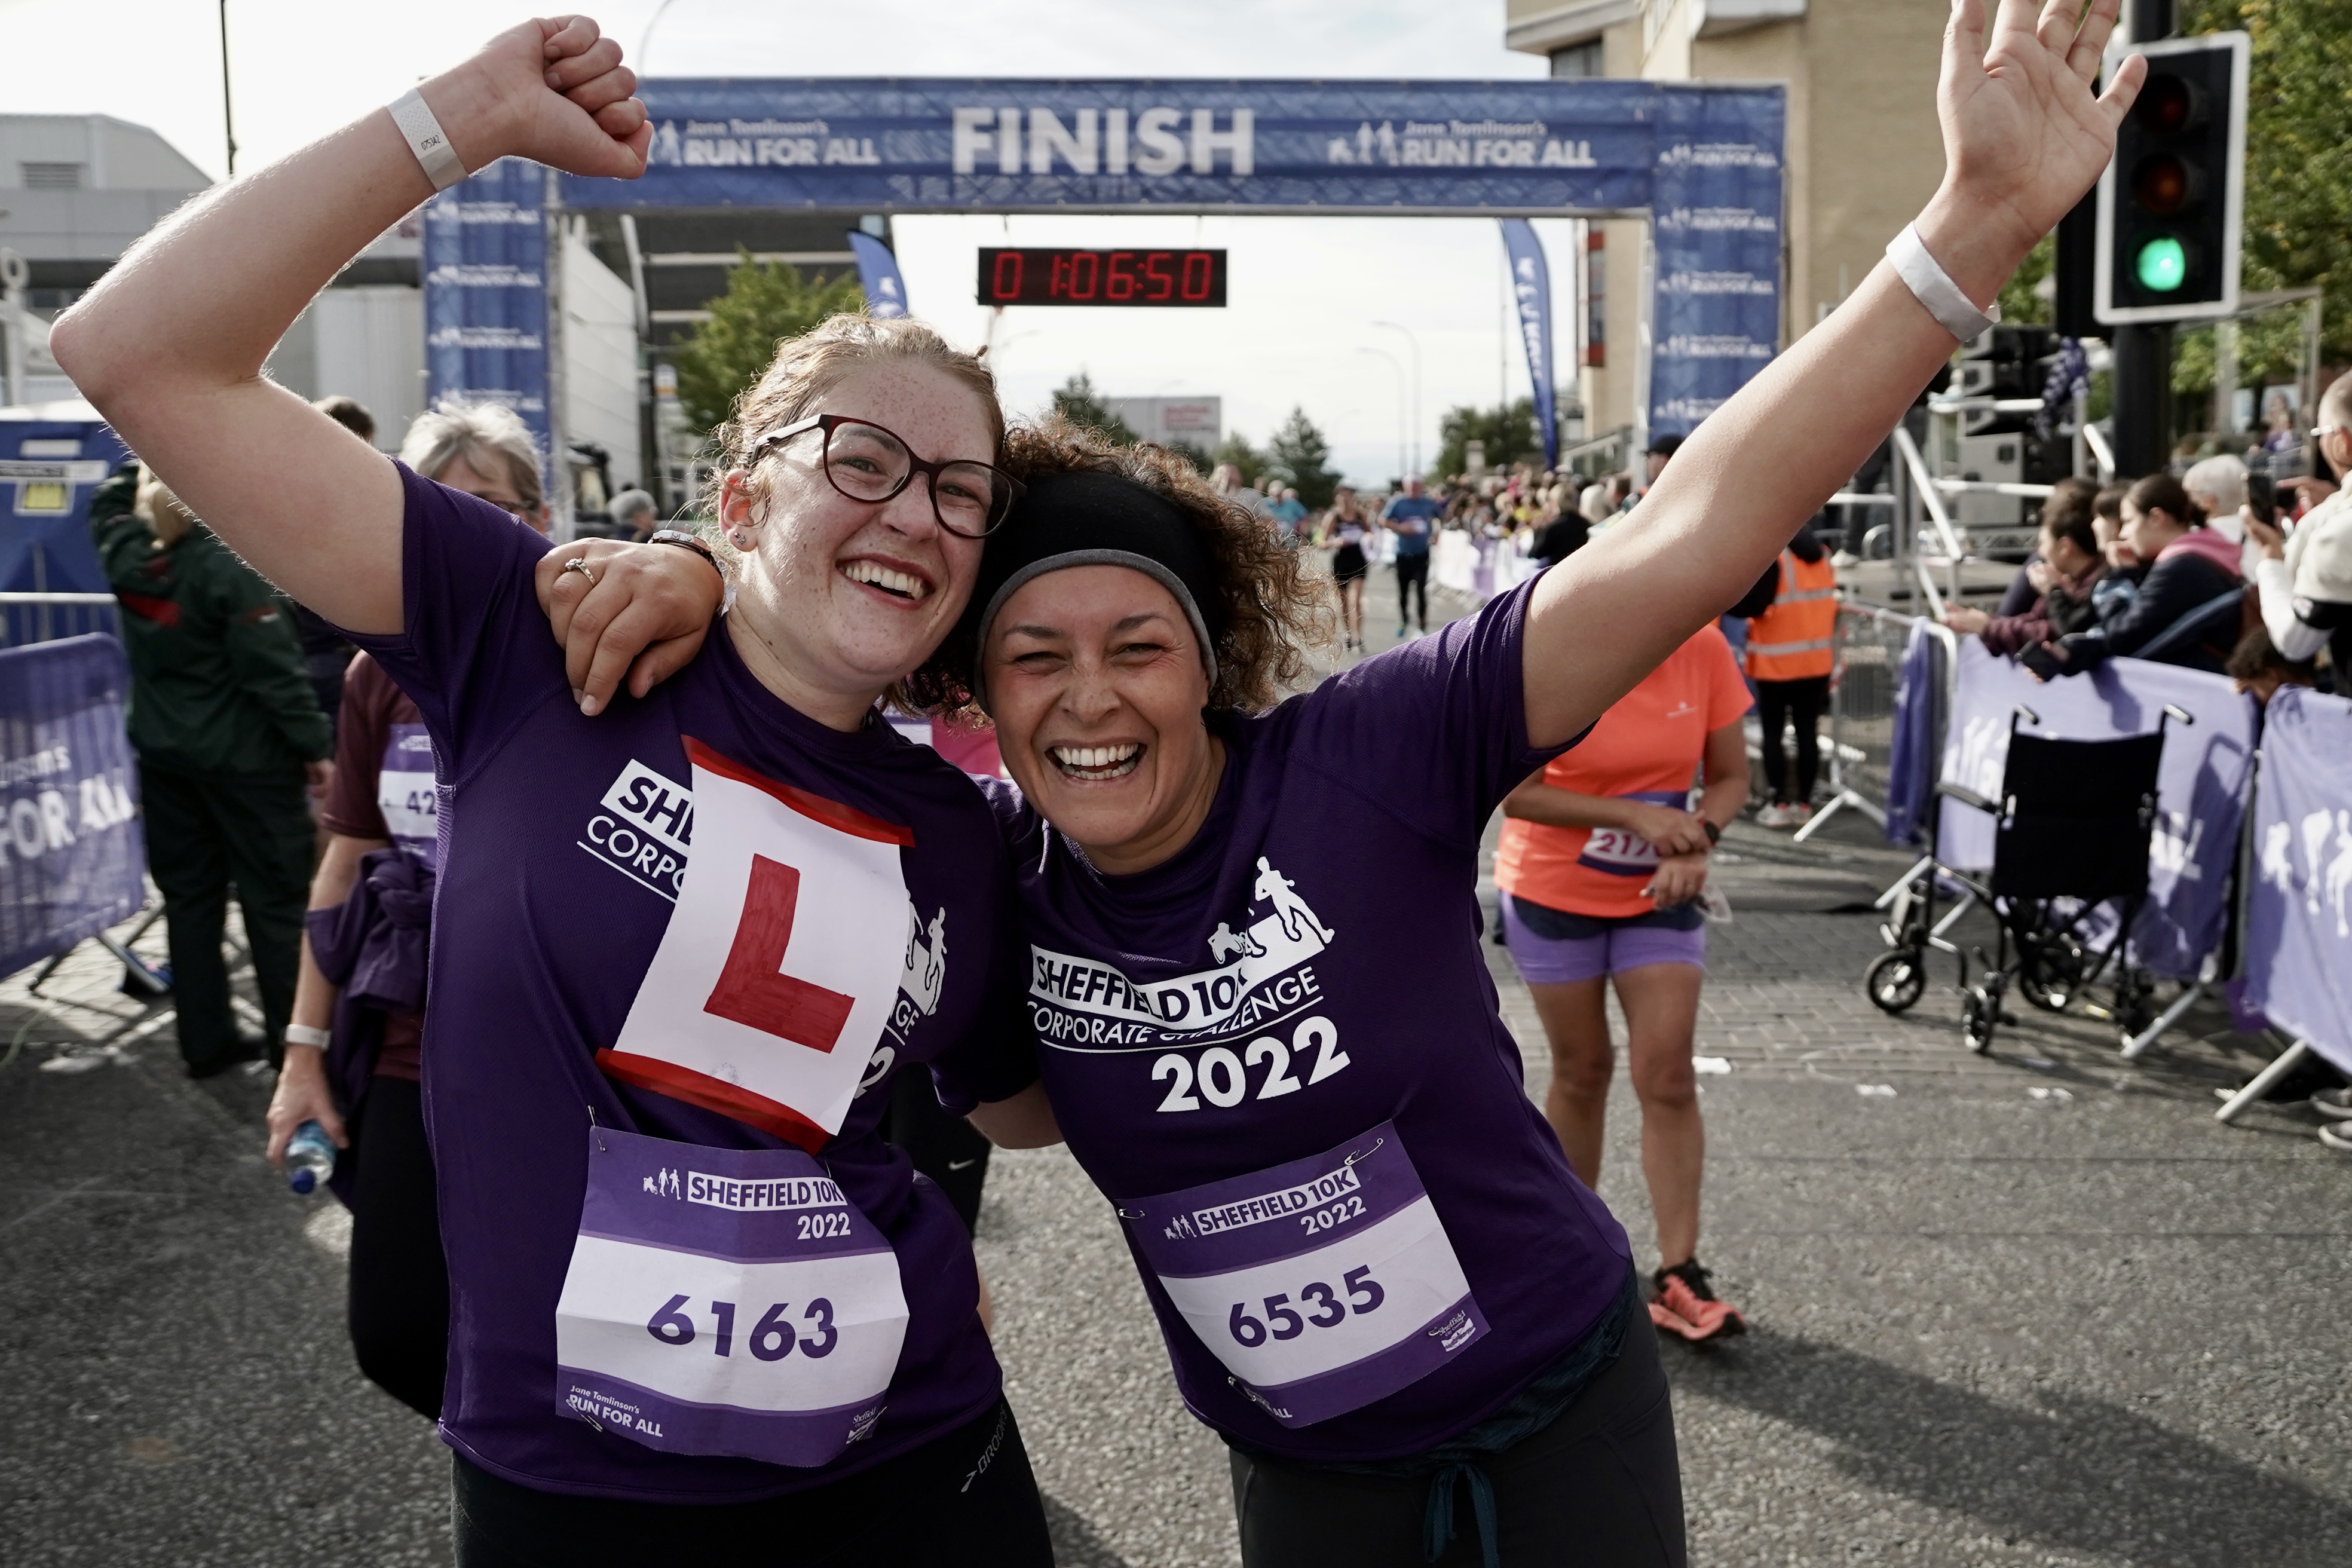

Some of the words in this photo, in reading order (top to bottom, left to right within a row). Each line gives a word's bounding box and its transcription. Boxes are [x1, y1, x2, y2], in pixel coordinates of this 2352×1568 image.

[684, 138, 754, 167] RUN
[755, 138, 819, 166] FOR
[822, 137, 881, 166] ALL
[952, 106, 1254, 175] FINISH
[1401, 138, 1471, 167] RUN
[1473, 138, 1537, 167] FOR
[1539, 139, 1598, 168] ALL
[703, 853, 856, 1054] L
[1152, 1016, 1351, 1112] 2022
[690, 1176, 811, 1207] SHEFFIELD
[813, 1180, 844, 1203] 10K
[1197, 1190, 1308, 1232] SHEFFIELD
[1308, 1168, 1356, 1202] 10K
[797, 1212, 851, 1240] 2022
[1300, 1196, 1367, 1236] 2022
[647, 1294, 838, 1362] 6163
[1229, 1264, 1385, 1348] 6535
[569, 1394, 600, 1416] RUN
[602, 1406, 633, 1428] FOR
[635, 1418, 663, 1438] ALL
[570, 1385, 591, 1397] Jane
[592, 1391, 640, 1414] Tomlinson's
